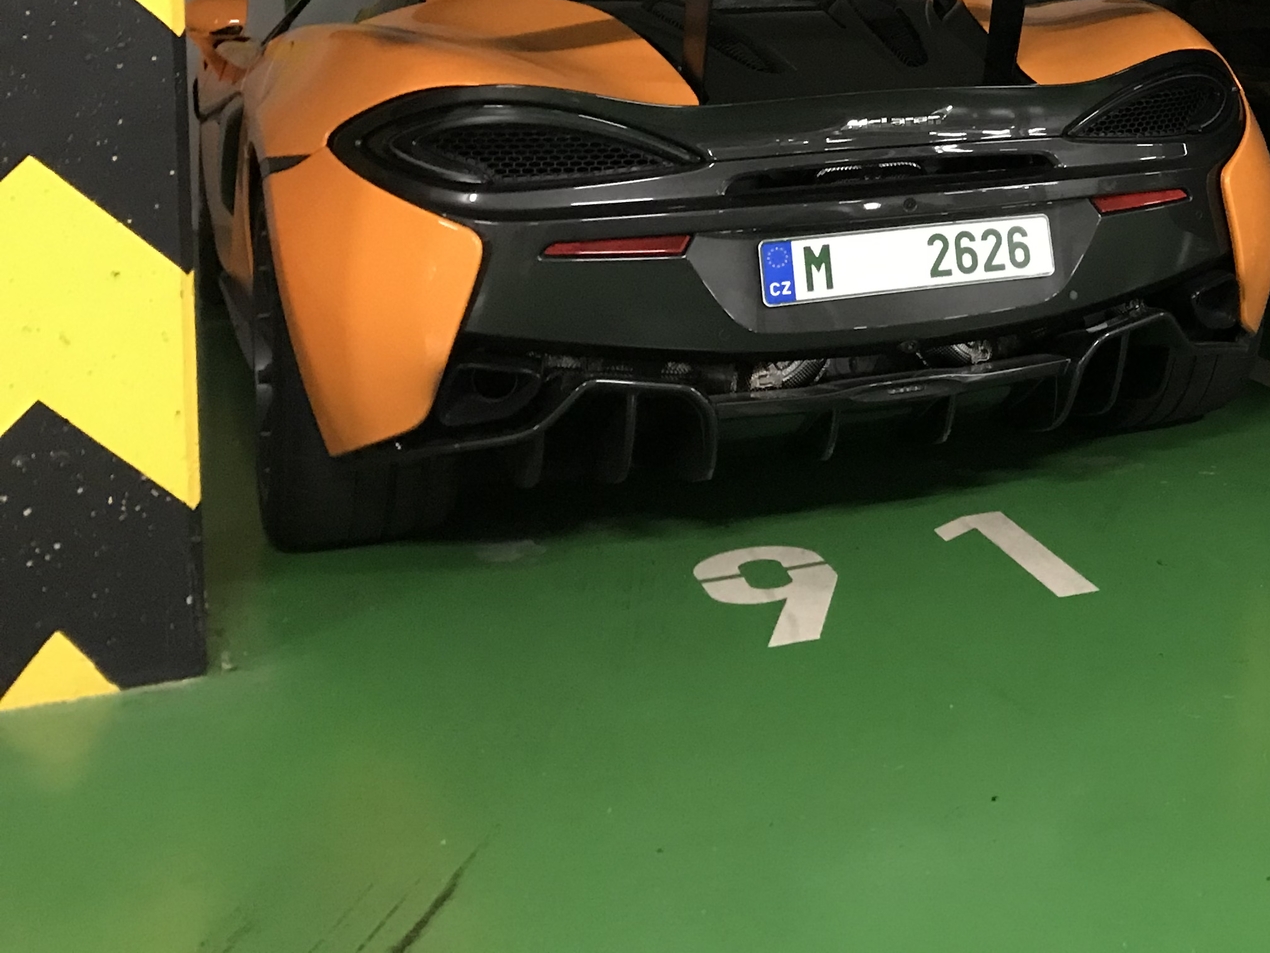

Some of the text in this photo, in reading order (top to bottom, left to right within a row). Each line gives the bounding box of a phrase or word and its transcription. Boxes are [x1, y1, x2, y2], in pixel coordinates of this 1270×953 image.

[803, 226, 1031, 293] M 2626
[769, 280, 792, 297] CZ
